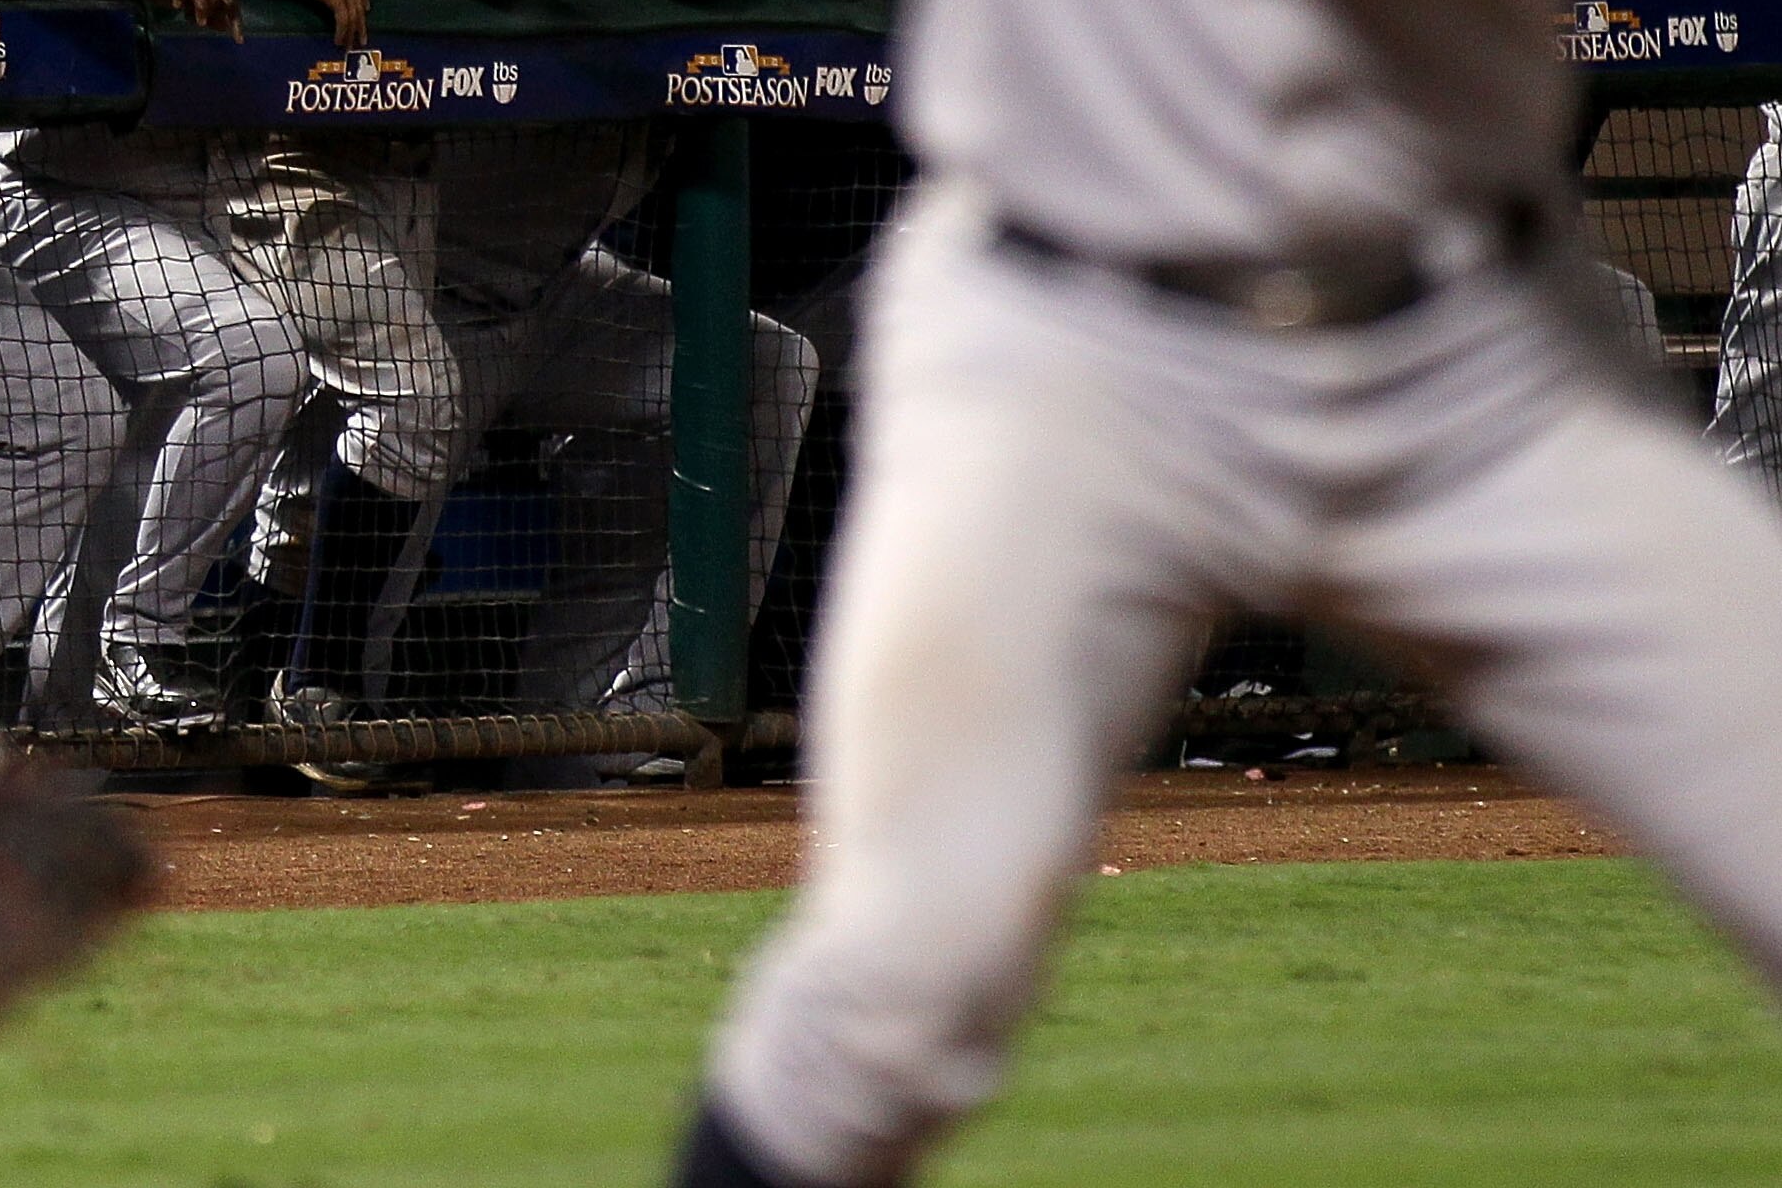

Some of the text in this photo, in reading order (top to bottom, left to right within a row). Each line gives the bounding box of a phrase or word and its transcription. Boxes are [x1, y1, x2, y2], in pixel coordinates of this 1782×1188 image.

[1668, 16, 1708, 46] FOX
[1715, 11, 1738, 31] tbs
[285, 62, 518, 112] POSTSEASON FOX tbs
[666, 63, 892, 107] POSTSEASON FOX tbs
